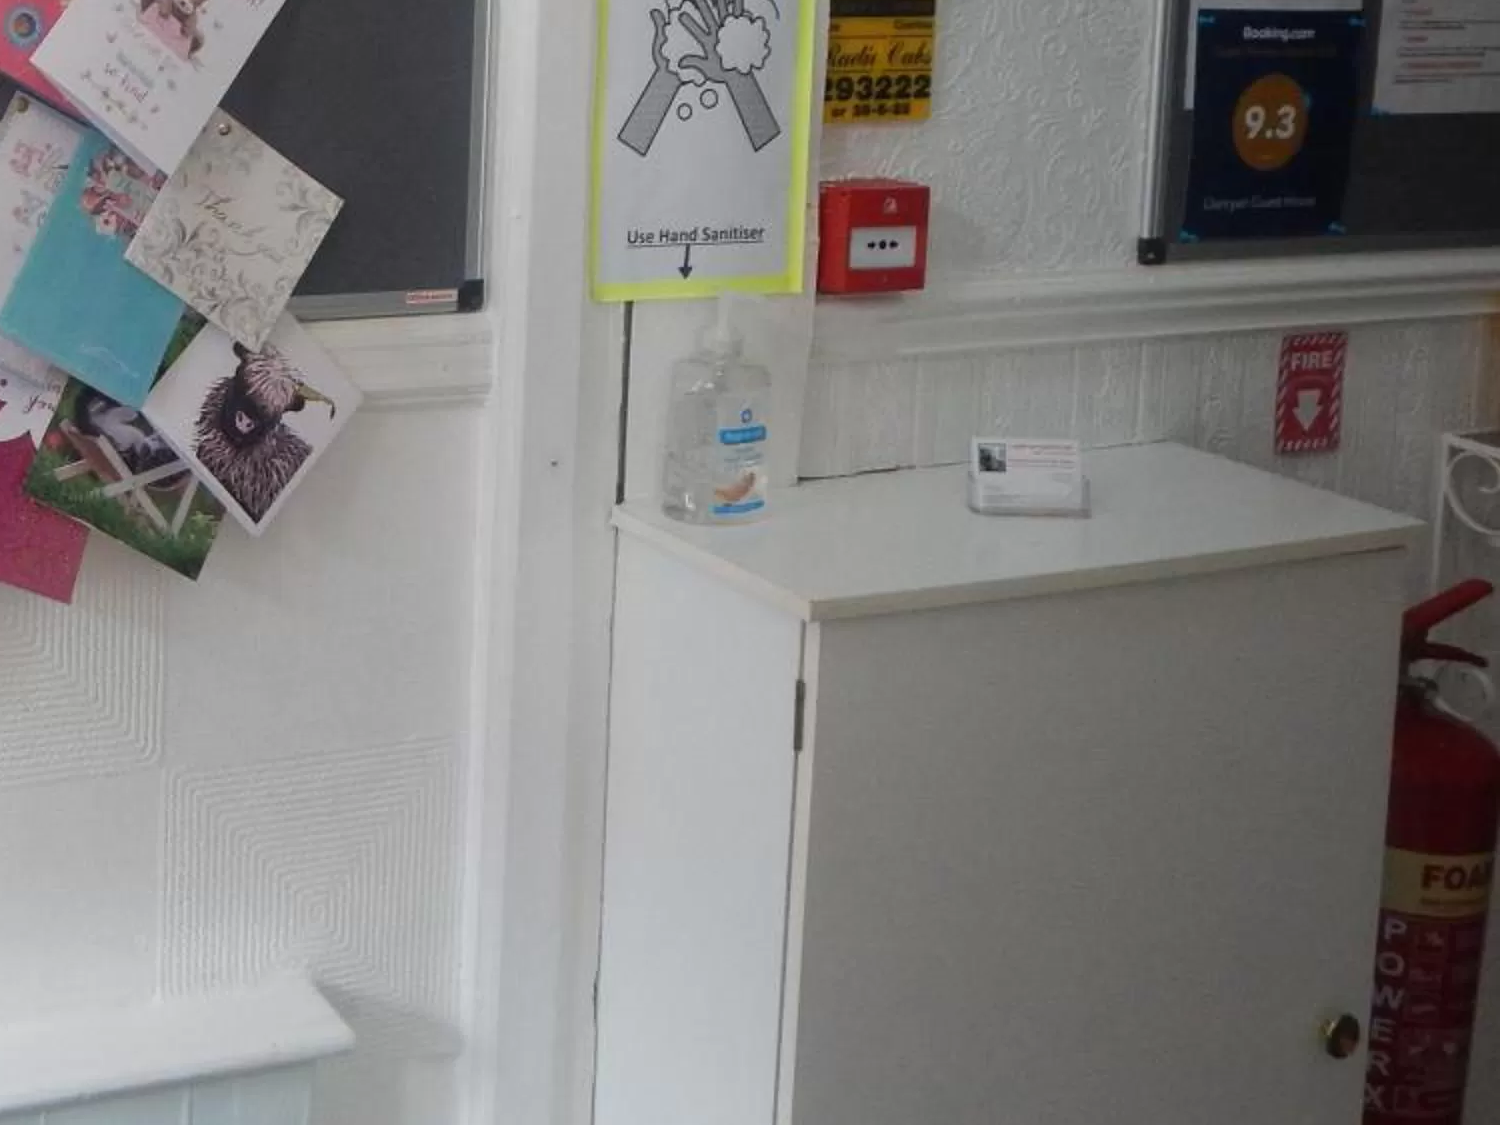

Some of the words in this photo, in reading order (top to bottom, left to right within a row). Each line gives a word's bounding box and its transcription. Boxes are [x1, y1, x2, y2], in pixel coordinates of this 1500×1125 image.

[1245, 105, 1296, 140] 9.3
[628, 230, 655, 244] Use
[660, 228, 698, 243] Hand
[702, 226, 765, 241] Sanitiser
[1292, 351, 1334, 370] FIRE
[1420, 865, 1491, 890] FOA
